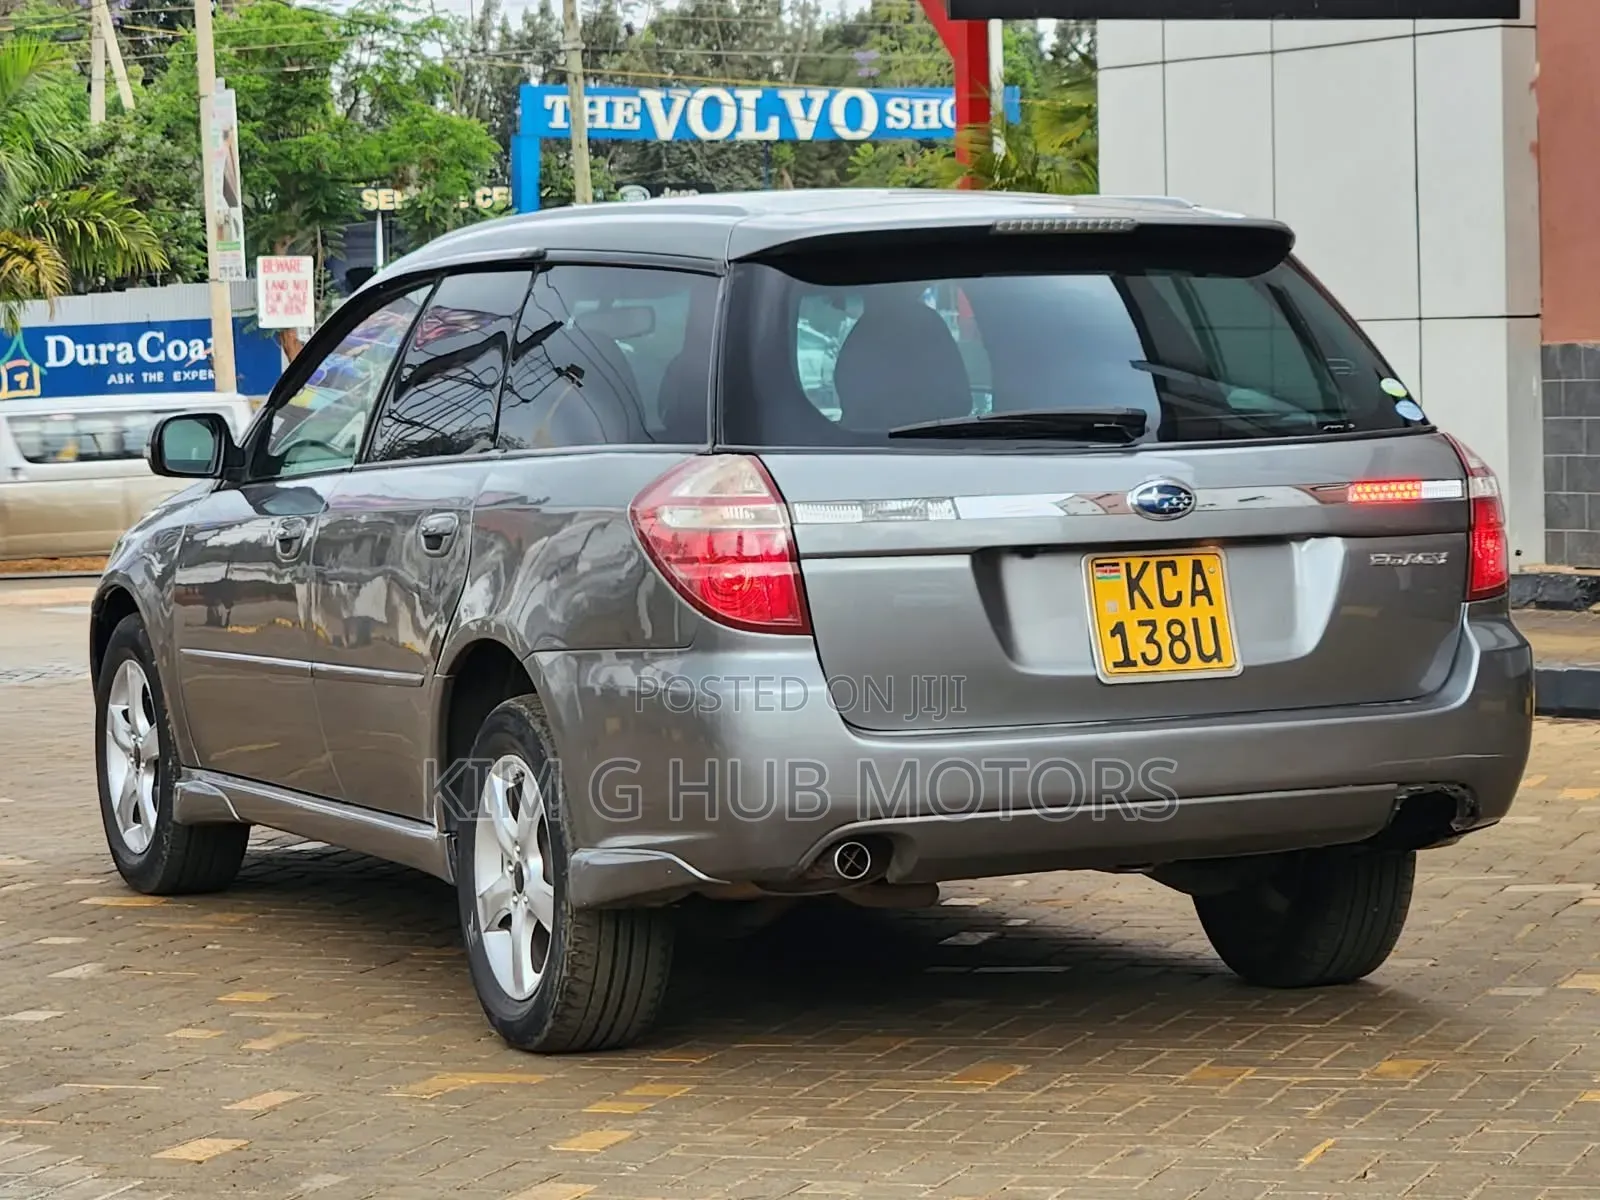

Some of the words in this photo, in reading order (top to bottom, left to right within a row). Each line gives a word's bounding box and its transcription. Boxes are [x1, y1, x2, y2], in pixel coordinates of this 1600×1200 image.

[544, 95, 640, 130] THE
[639, 87, 878, 141] VOLVO
[885, 97, 957, 129] SHO
[107, 372, 134, 385] ASK
[142, 371, 164, 383] THE
[173, 368, 215, 382] EXPER
[1125, 559, 1214, 611] KCA
[1109, 616, 1223, 669] 138U
